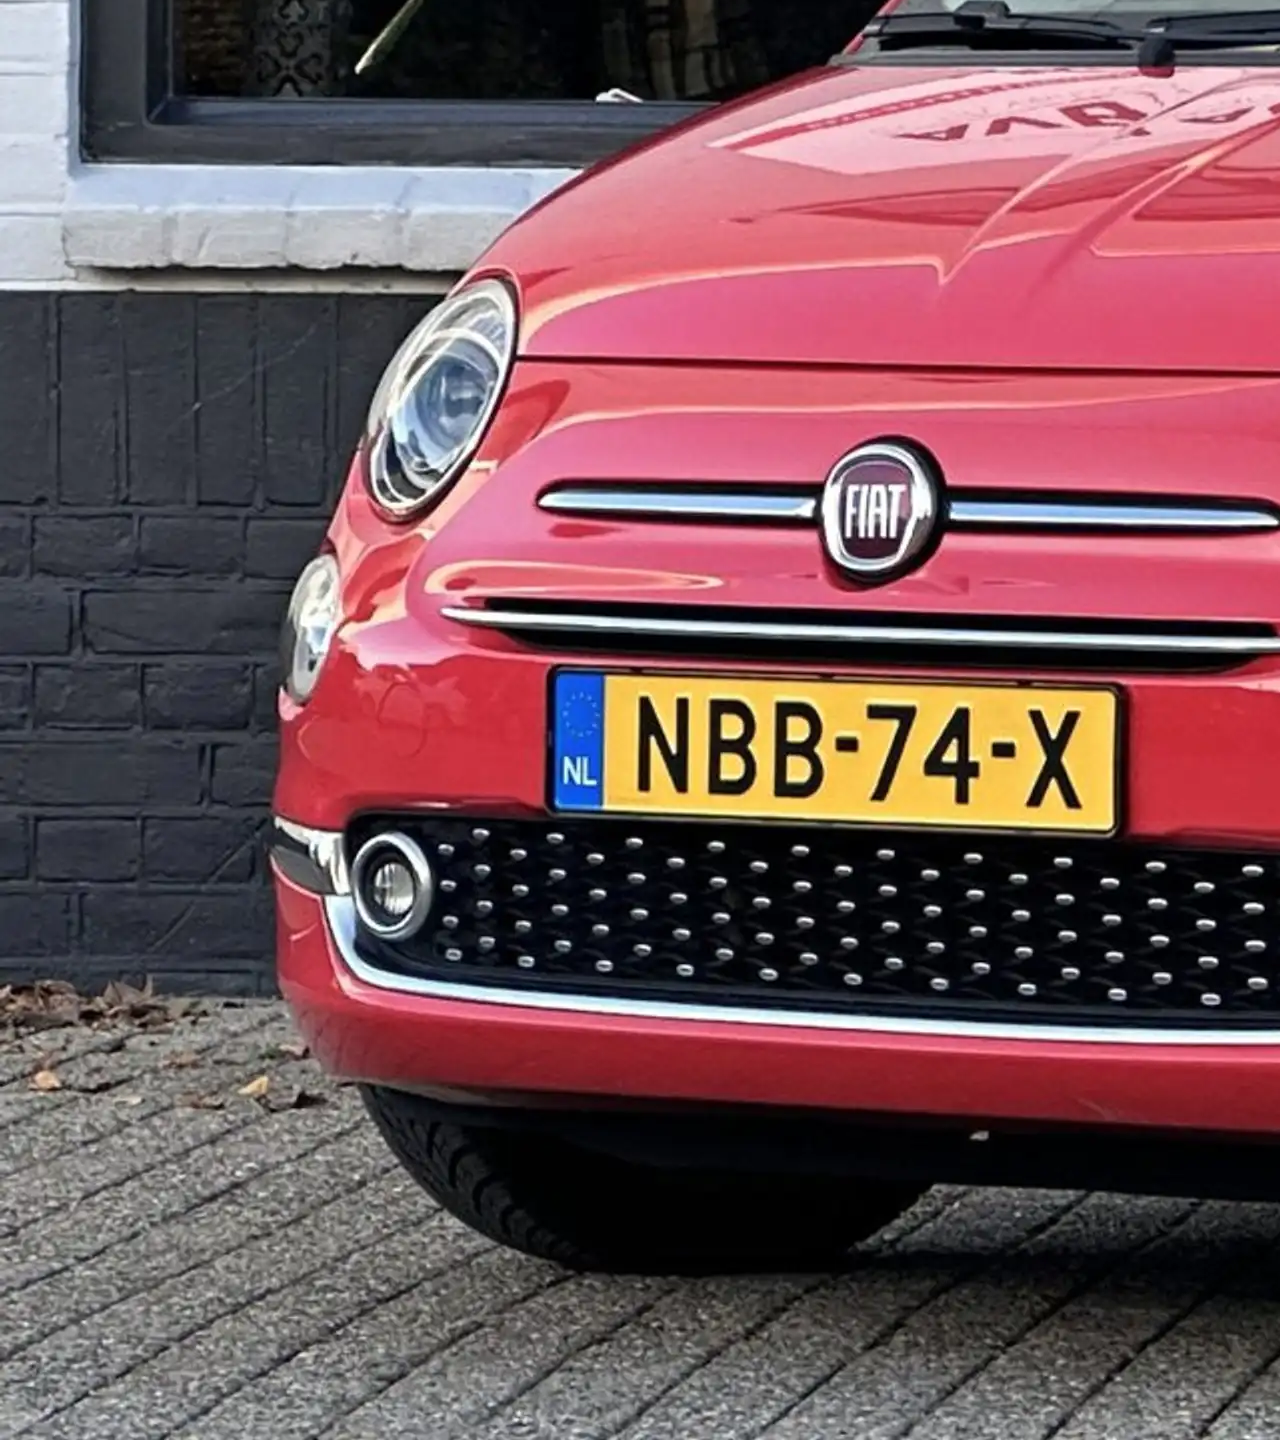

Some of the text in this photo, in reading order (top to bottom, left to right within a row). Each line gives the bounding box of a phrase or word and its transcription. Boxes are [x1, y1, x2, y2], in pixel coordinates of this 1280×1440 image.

[844, 483, 907, 539] FIAT
[563, 694, 1083, 810] NL NBB-74-X
